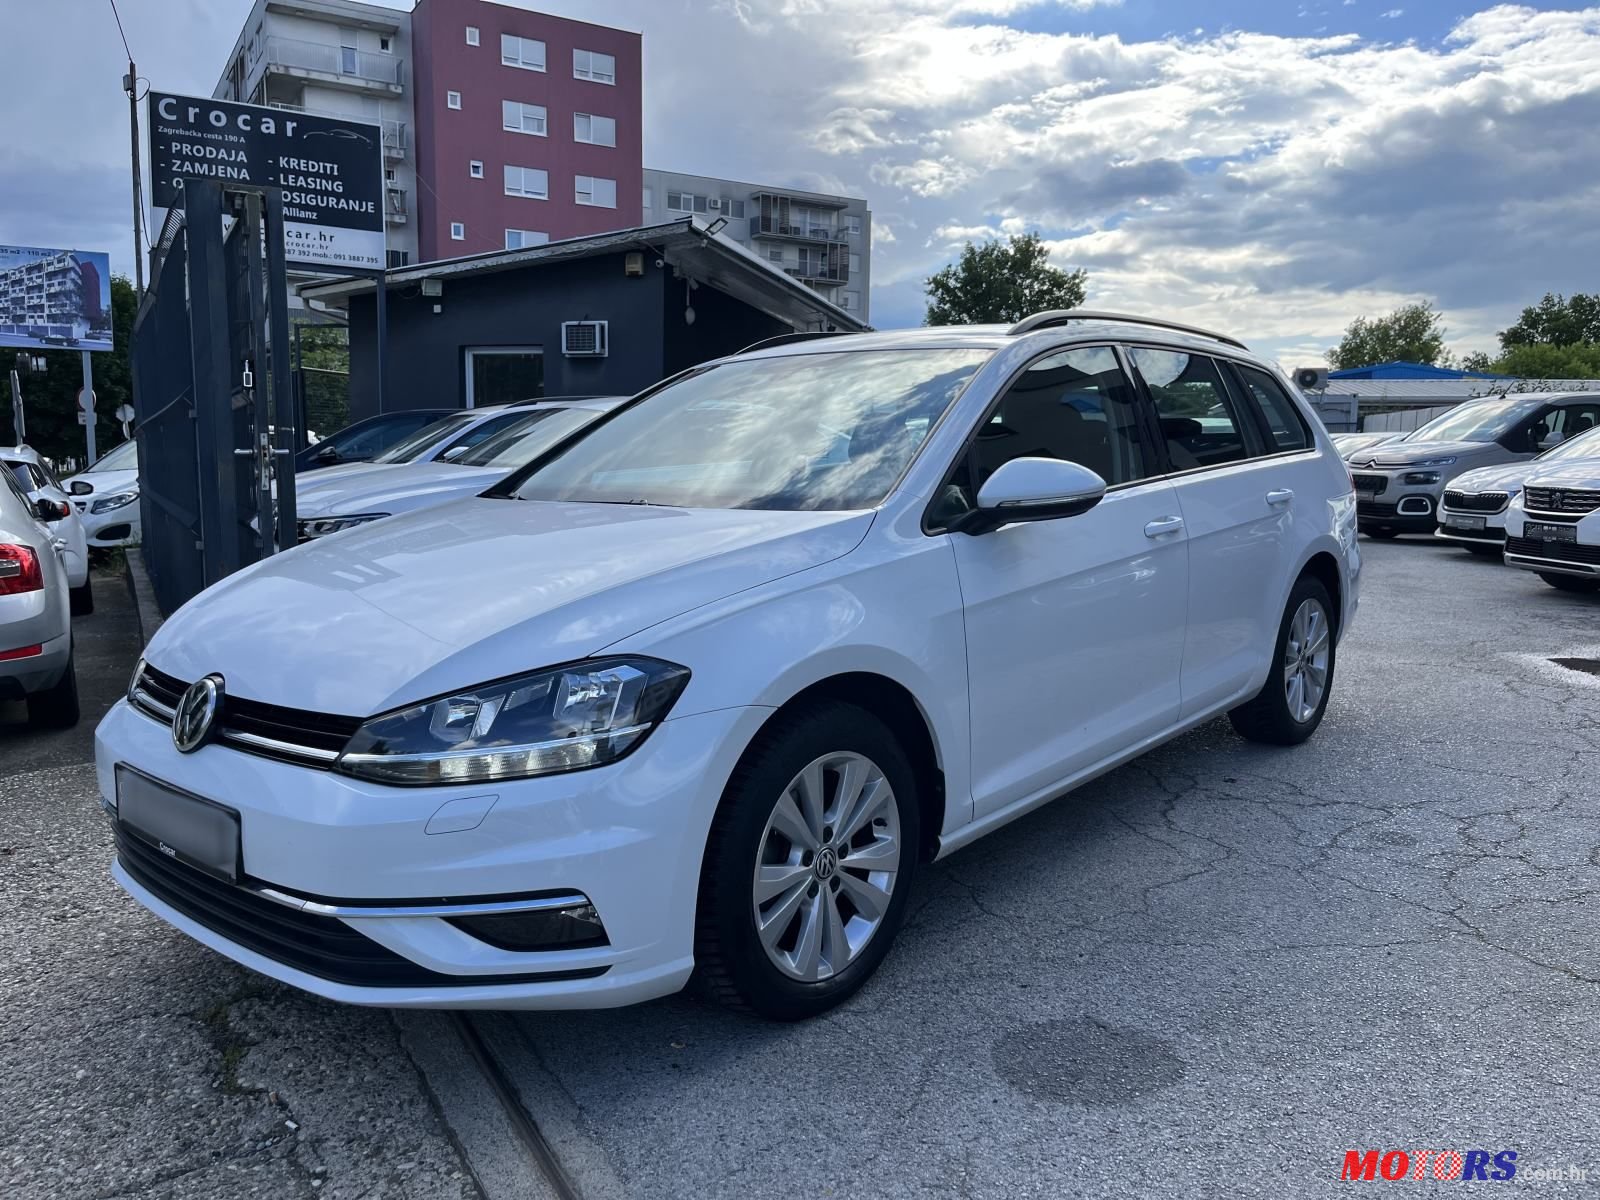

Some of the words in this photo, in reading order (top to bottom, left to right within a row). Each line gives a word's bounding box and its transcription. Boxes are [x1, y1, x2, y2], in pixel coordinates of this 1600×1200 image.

[158, 98, 297, 137] Crocar
[203, 132, 223, 141] cesta
[224, 134, 238, 143] 190
[239, 136, 246, 144] A
[171, 141, 248, 164] PRODAJA
[171, 159, 251, 181] ZAMJENA
[279, 156, 339, 176] KREDITI
[279, 173, 344, 193] LEASING
[281, 190, 376, 214] OSIGURANJE
